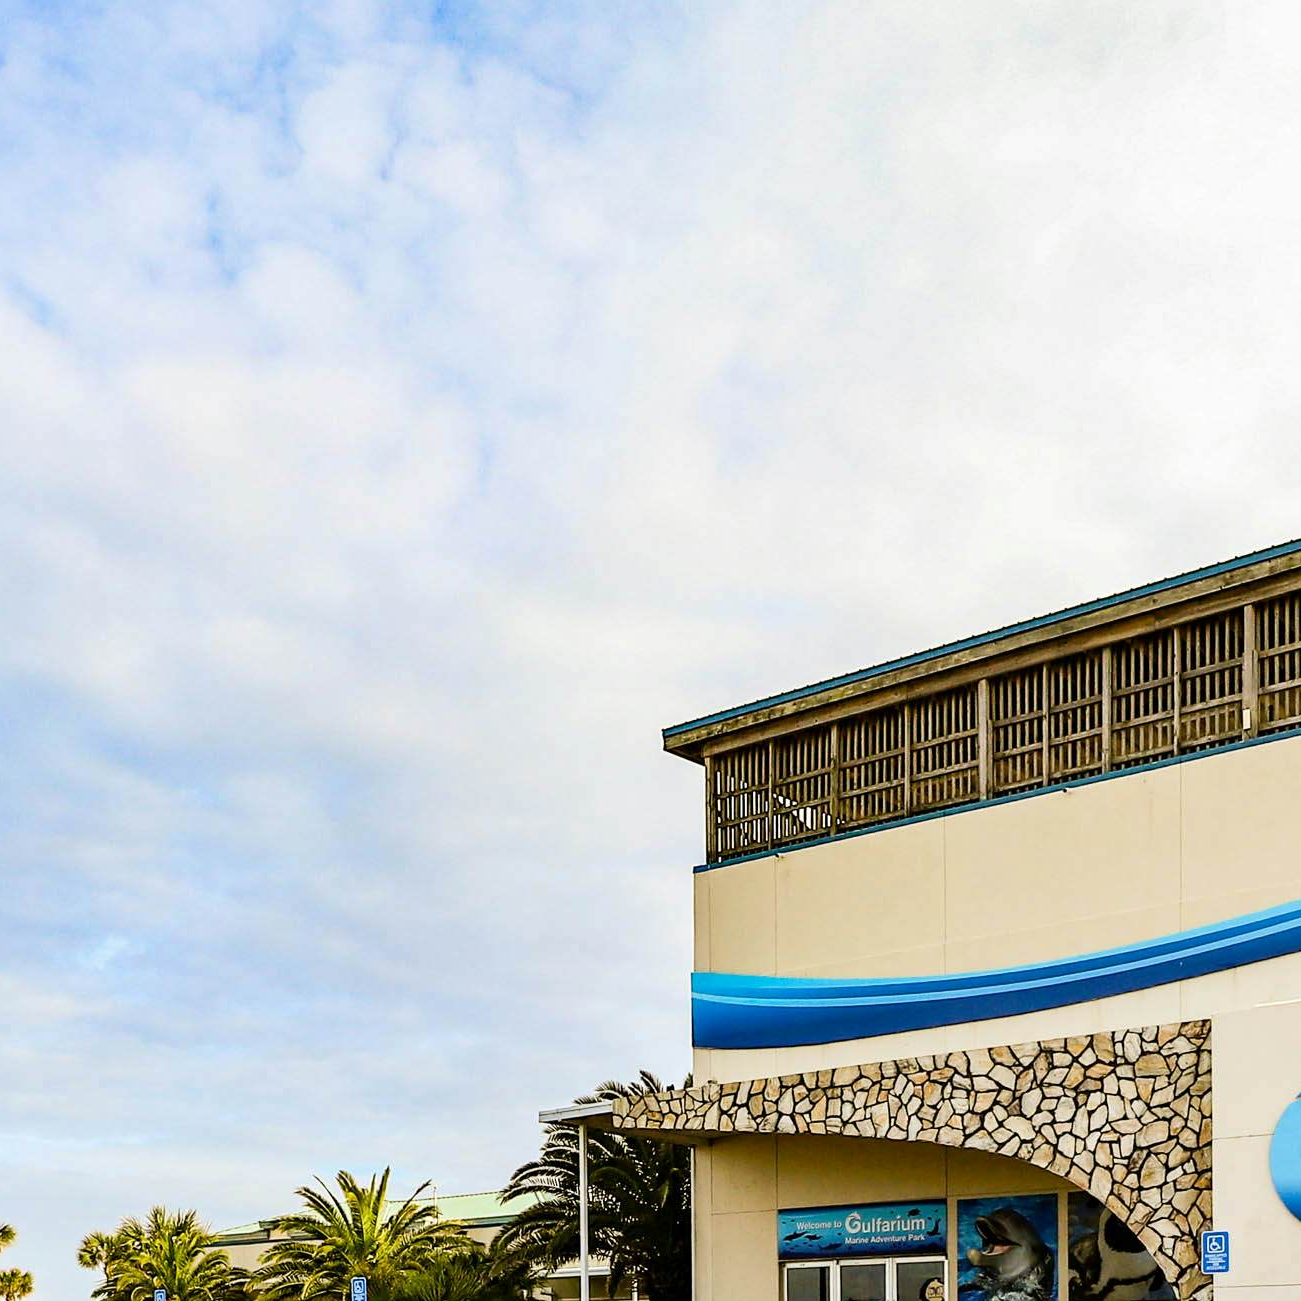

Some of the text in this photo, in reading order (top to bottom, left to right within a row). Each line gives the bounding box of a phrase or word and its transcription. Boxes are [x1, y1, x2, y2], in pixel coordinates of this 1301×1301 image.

[796, 1212, 926, 1234] Welcome to Gulfarium
[870, 1235, 907, 1243] Adventure
[908, 1233, 925, 1241] Park
